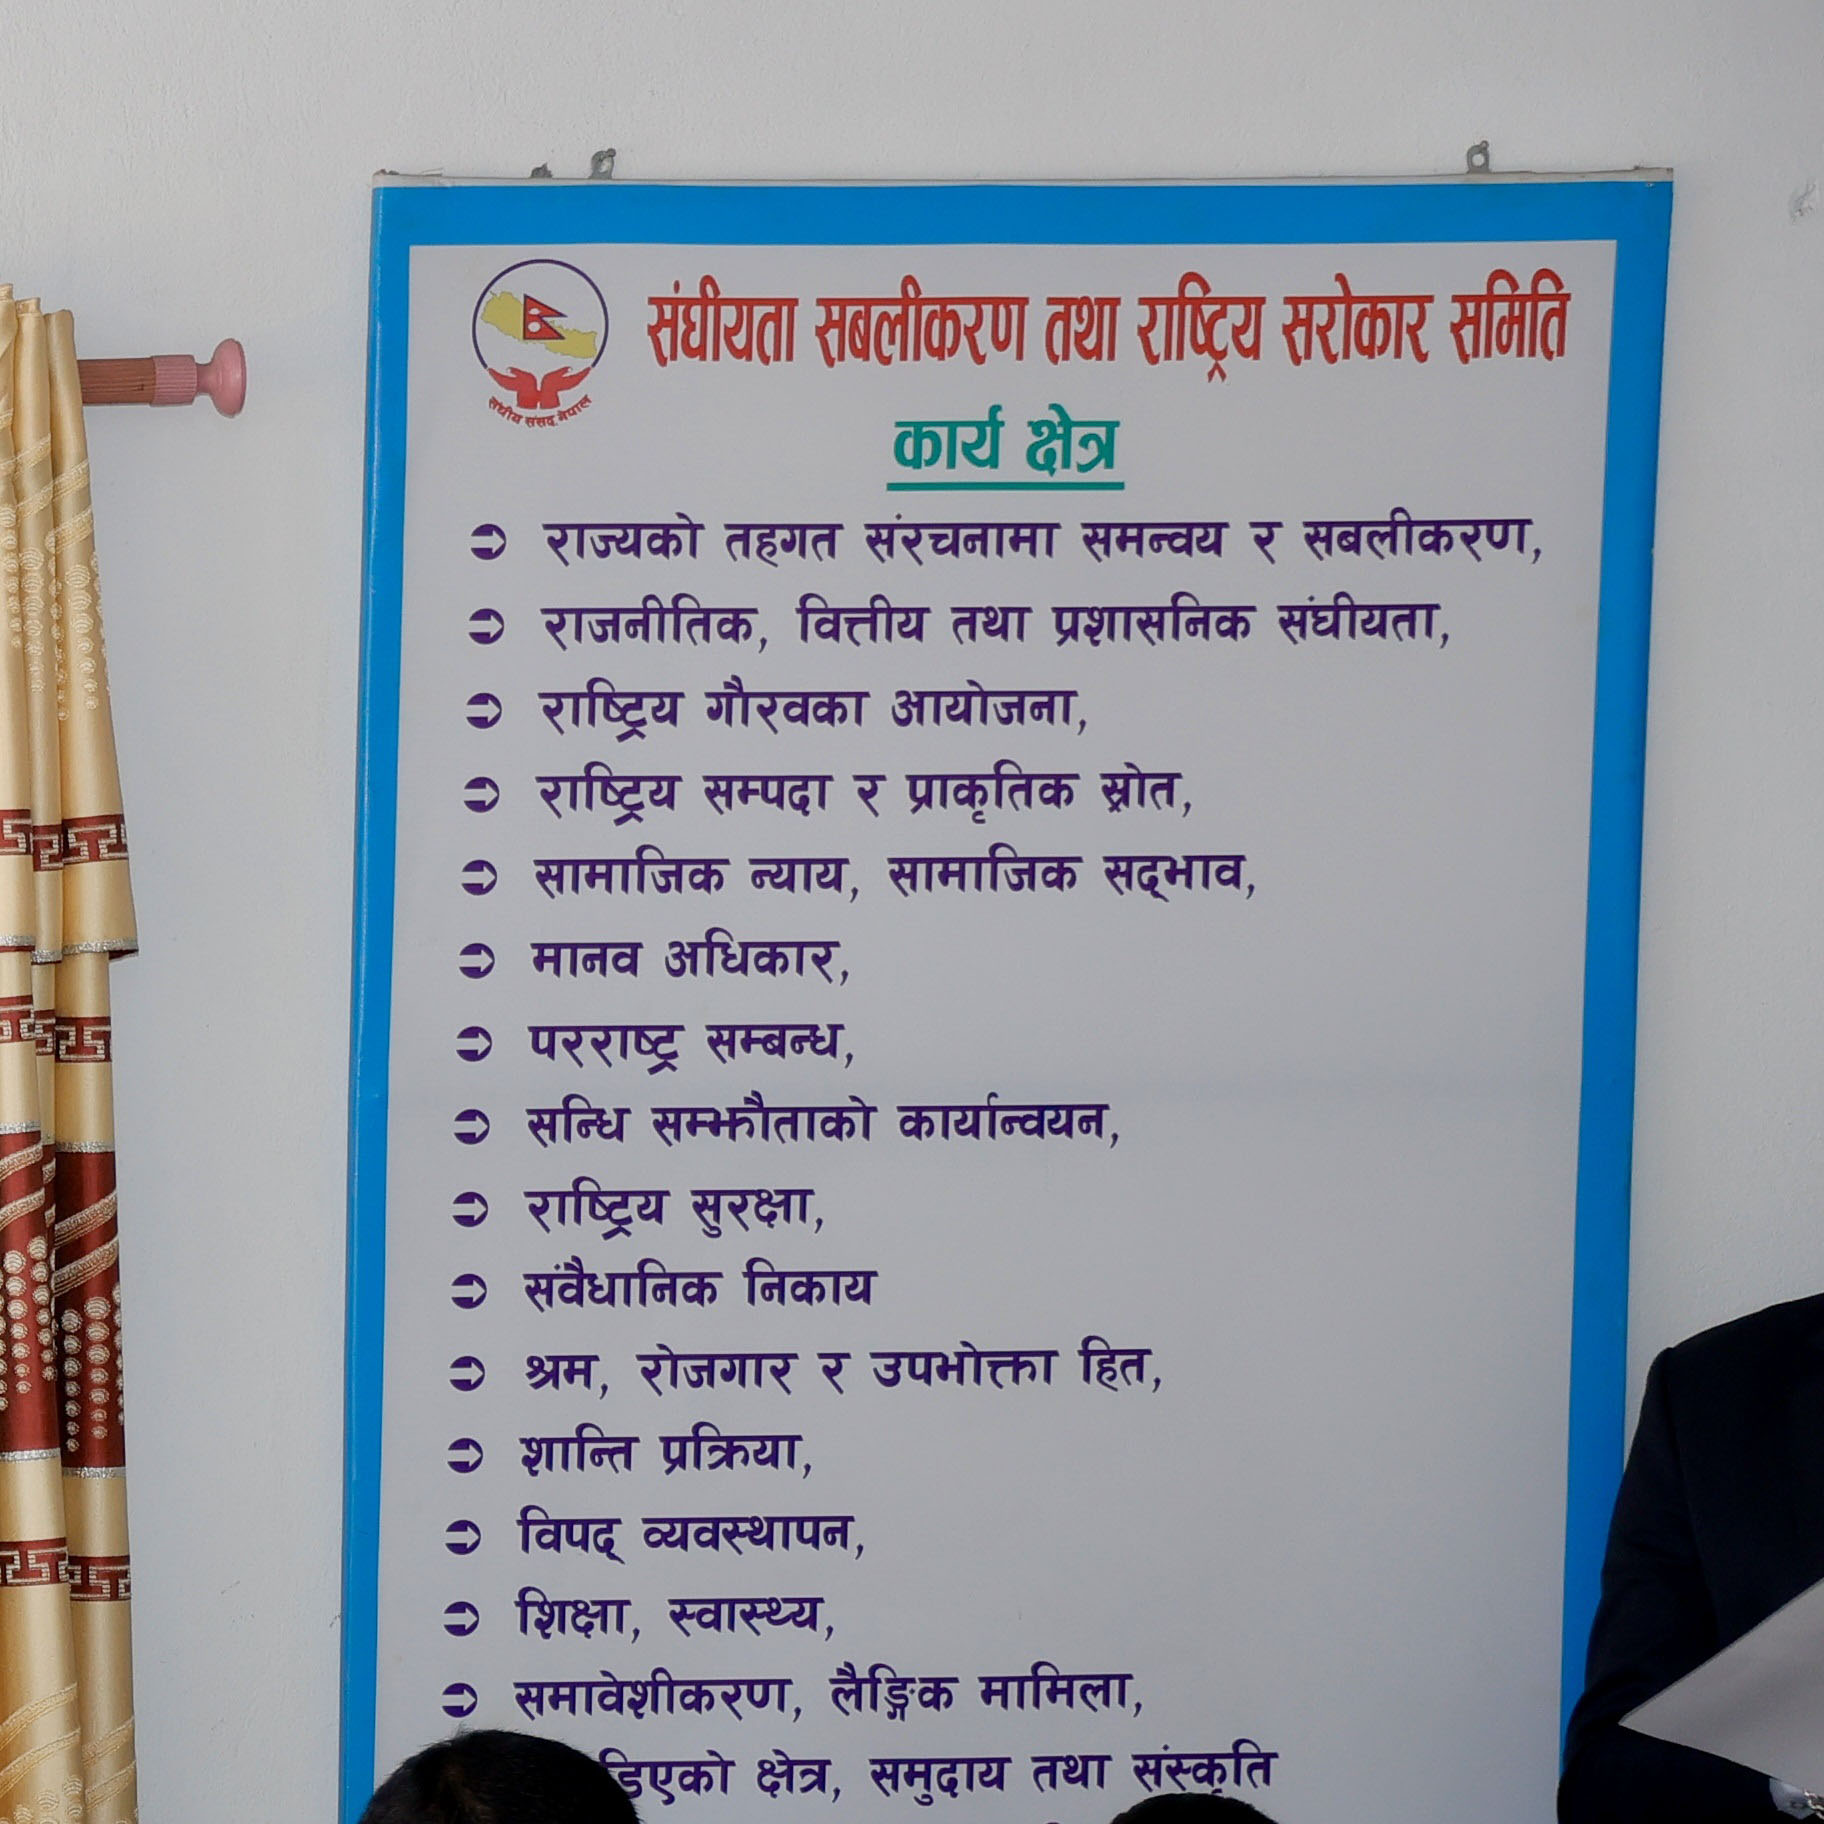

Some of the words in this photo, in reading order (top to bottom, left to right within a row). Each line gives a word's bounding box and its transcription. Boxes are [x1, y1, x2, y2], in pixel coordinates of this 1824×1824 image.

[647, 274, 800, 368] संघीयता
[815, 274, 1030, 368] सबलीकरण
[1045, 296, 1123, 365] तथा
[1137, 272, 1267, 382] राष्ट्रिय
[1282, 272, 1435, 366] सरोकार
[1449, 268, 1572, 365] समिति
[894, 402, 1006, 470] कार्य
[1026, 402, 1121, 477] क्षेत्र
[542, 512, 705, 566] राज्यको
[724, 523, 844, 567] तहगत
[864, 512, 1061, 566] संरचनामा
[1081, 522, 1230, 562] समन्वय
[1249, 522, 1284, 564] र
[1303, 507, 1541, 564] सबलीकरण,
[540, 593, 767, 653] राजनीतिक,
[795, 593, 931, 646] वित्तीय
[951, 606, 1033, 644] तथा
[1051, 591, 1257, 648] प्रशासनिक
[1277, 591, 1448, 648] संघीयता,
[538, 677, 685, 742] राष्ट्रिय
[704, 675, 870, 734] गौरवका
[892, 680, 1086, 735] आयोजना,
[535, 761, 683, 826] राष्ट्रिय
[702, 775, 834, 816] सम्पदा
[853, 775, 886, 817] र
[905, 759, 1080, 824] प्राकृतिक
[1100, 762, 1191, 817] स्रोत,
[534, 844, 730, 899] सामाजिक
[749, 858, 858, 902] न्याय,
[887, 842, 1083, 897] सामाजिक
[530, 942, 644, 977] मानव
[665, 927, 848, 985] अधिकार,
[528, 1025, 685, 1075] परराष्ट्र
[705, 1024, 853, 1068] सम्बन्ध,
[526, 1093, 632, 1148] सन्धि
[651, 1090, 878, 1147] सम्झौताको
[897, 1092, 1118, 1148] कार्यान्वयन,
[524, 1176, 671, 1240] राष्ट्रिय
[690, 1189, 823, 1238] सुरक्षा,
[523, 1255, 724, 1312] संवैधानिक
[742, 1257, 878, 1306] निकाय
[526, 1355, 608, 1399] श्रम,
[636, 1344, 800, 1396] रोजगार
[817, 1353, 851, 1394] र
[869, 1341, 1059, 1389] उपभोक्ता
[1077, 1336, 1161, 1393] हित,
[519, 1423, 640, 1477] शान्ति
[659, 1422, 811, 1479] प्रक्रिया,
[516, 1504, 625, 1564] विपद्
[641, 1515, 864, 1560] व्यवस्थापन,
[514, 1586, 640, 1643] शिक्षा,
[668, 1597, 834, 1641] स्वास्थ्य,
[513, 1667, 801, 1722] समावेशीकरण,
[829, 1661, 960, 1721] लैङ्गिक
[978, 1661, 1142, 1717] मामिला,
[598, 1747, 736, 1806] डिएको
[757, 1749, 840, 1803] क्षेत्र,
[868, 1757, 1012, 1806] समुदाय
[1031, 1755, 1113, 1793] तथा
